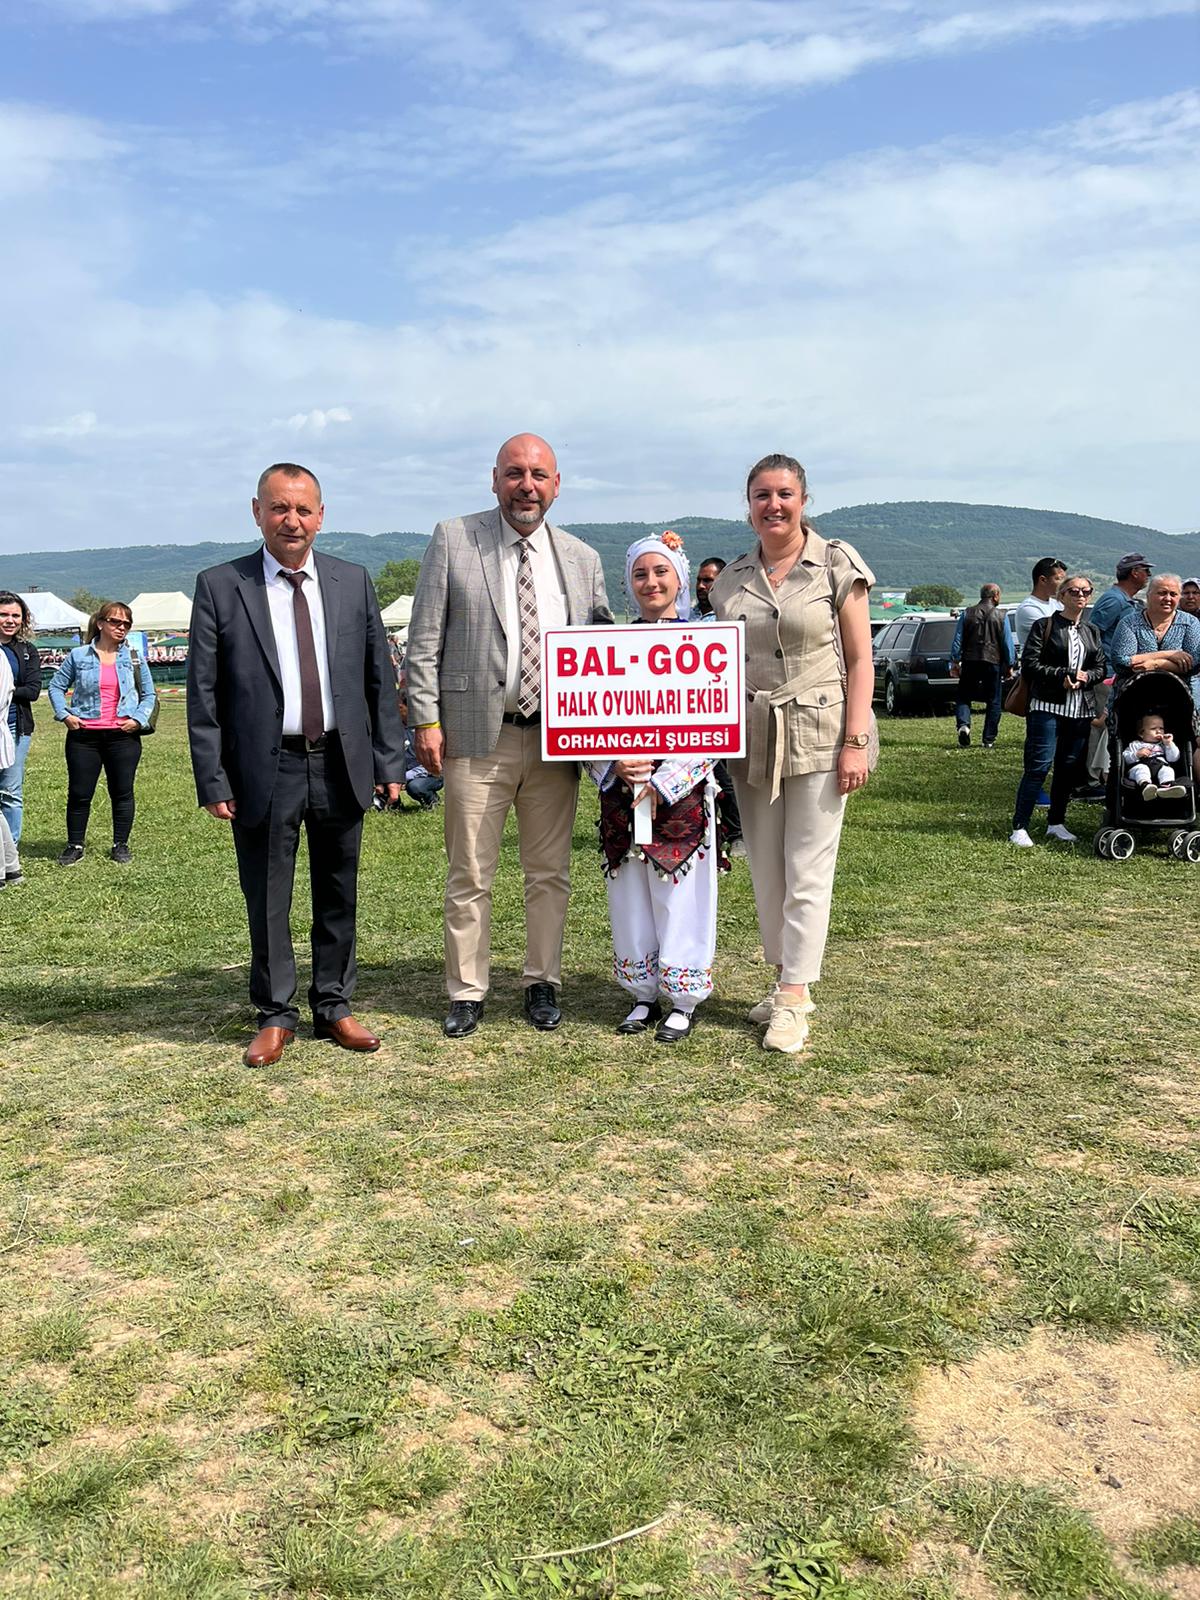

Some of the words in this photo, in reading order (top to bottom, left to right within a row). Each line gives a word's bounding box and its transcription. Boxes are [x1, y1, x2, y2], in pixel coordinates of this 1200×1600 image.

[557, 691, 598, 717] HALK
[603, 690, 681, 716] OYUNLARI
[687, 681, 729, 714] EKİBİ
[557, 729, 660, 750] ORHANGAZİ
[665, 728, 729, 751] ŞUBESİ
